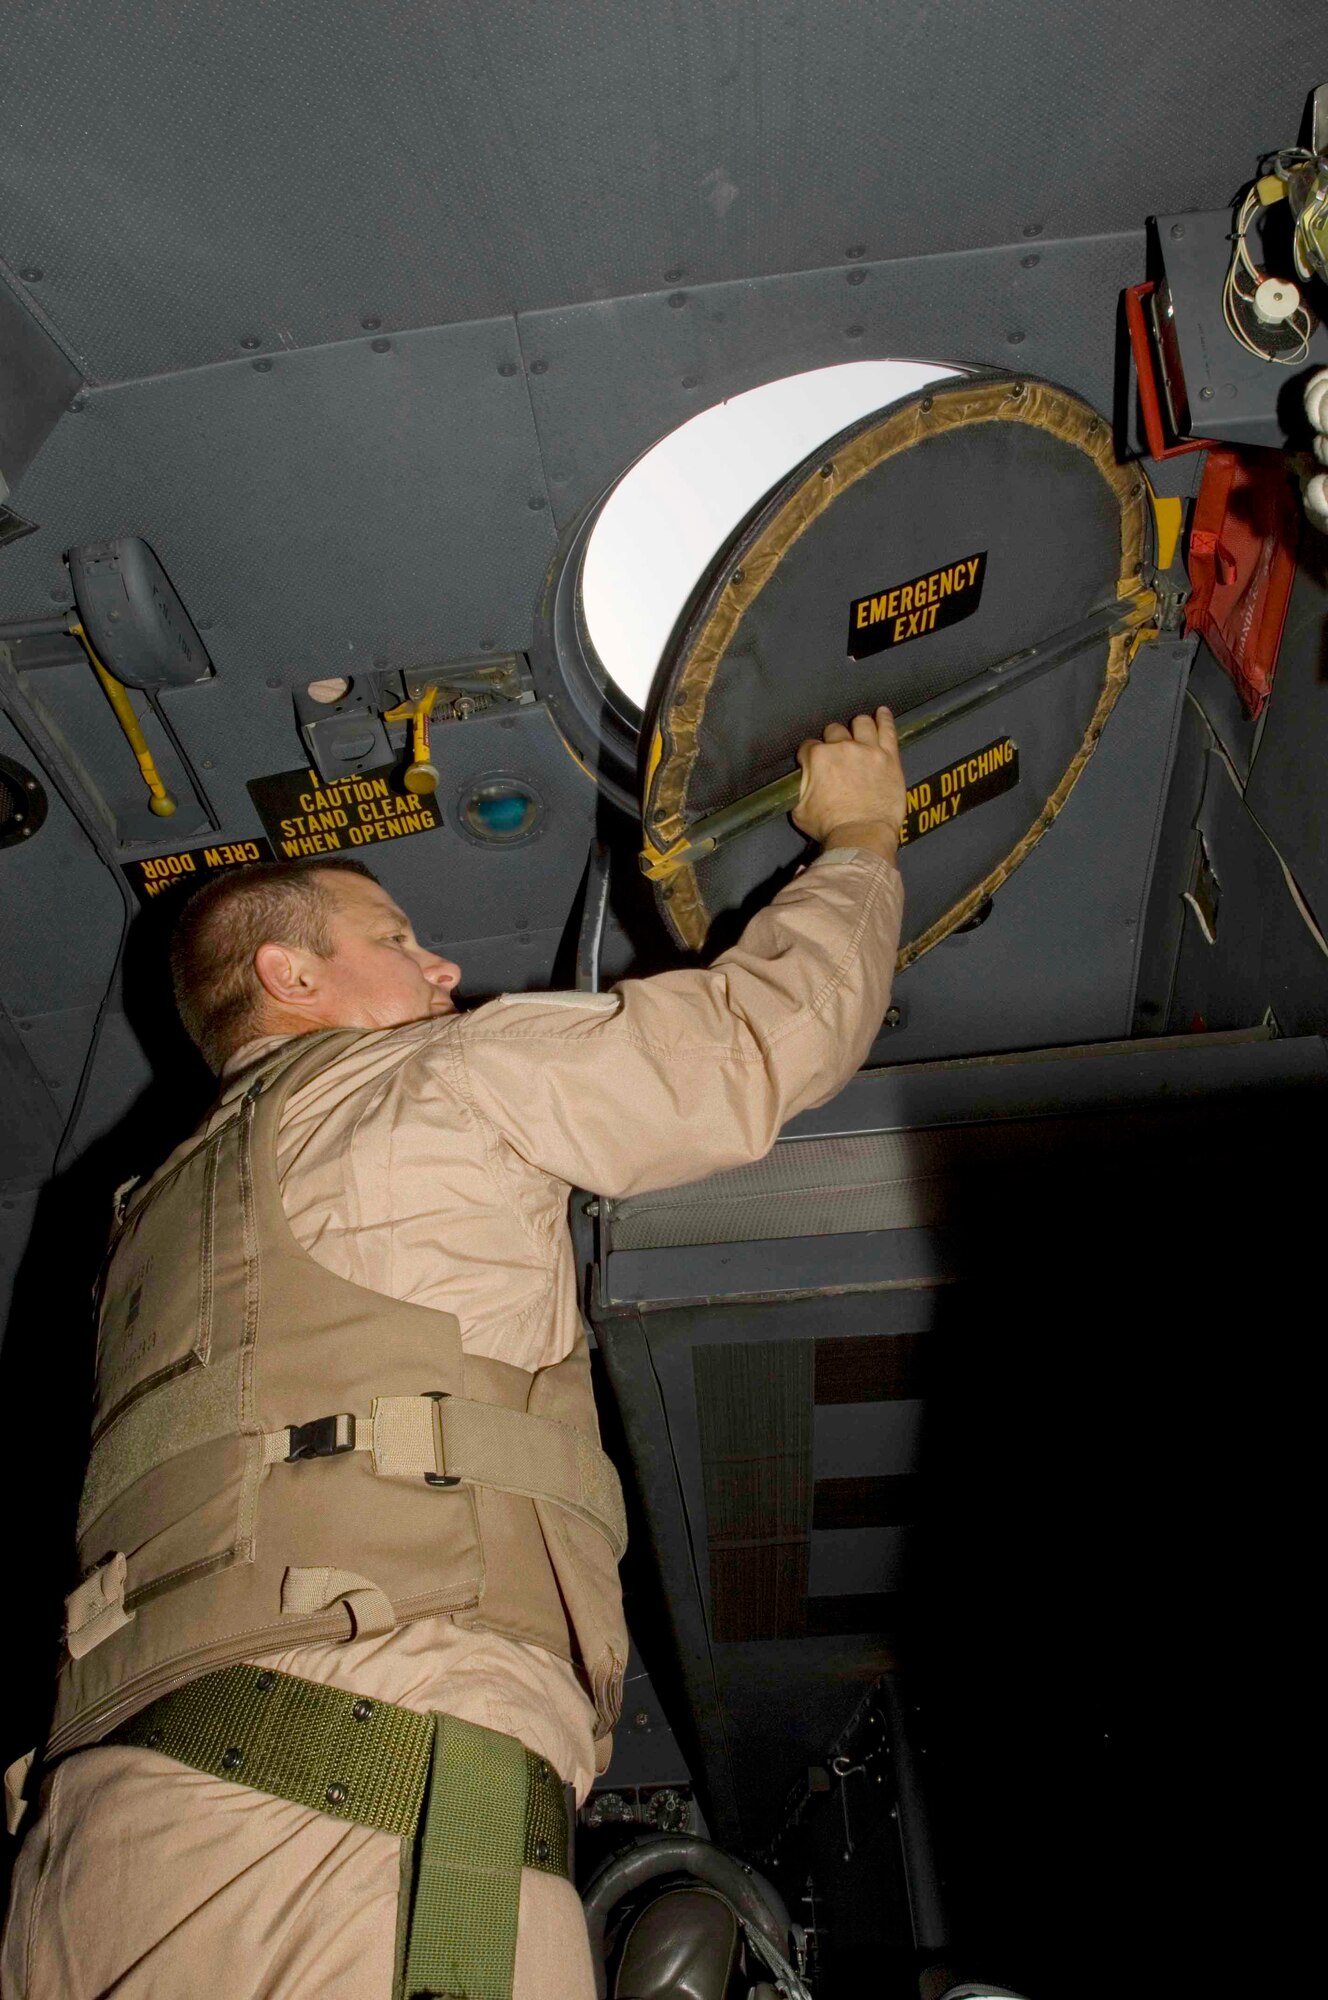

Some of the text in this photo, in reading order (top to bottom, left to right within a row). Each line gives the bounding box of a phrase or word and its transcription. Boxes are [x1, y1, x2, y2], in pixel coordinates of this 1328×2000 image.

[856, 557, 980, 630] EMERGENCY
[892, 603, 941, 643] EXIT
[299, 778, 390, 813] CAUTION
[906, 739, 1014, 815] ND DITCHING
[280, 793, 423, 838] STAND CLEAR
[281, 810, 436, 859] WHEN OPENING
[918, 793, 962, 834] ONLY
[140, 842, 261, 879] CREW DOOR
